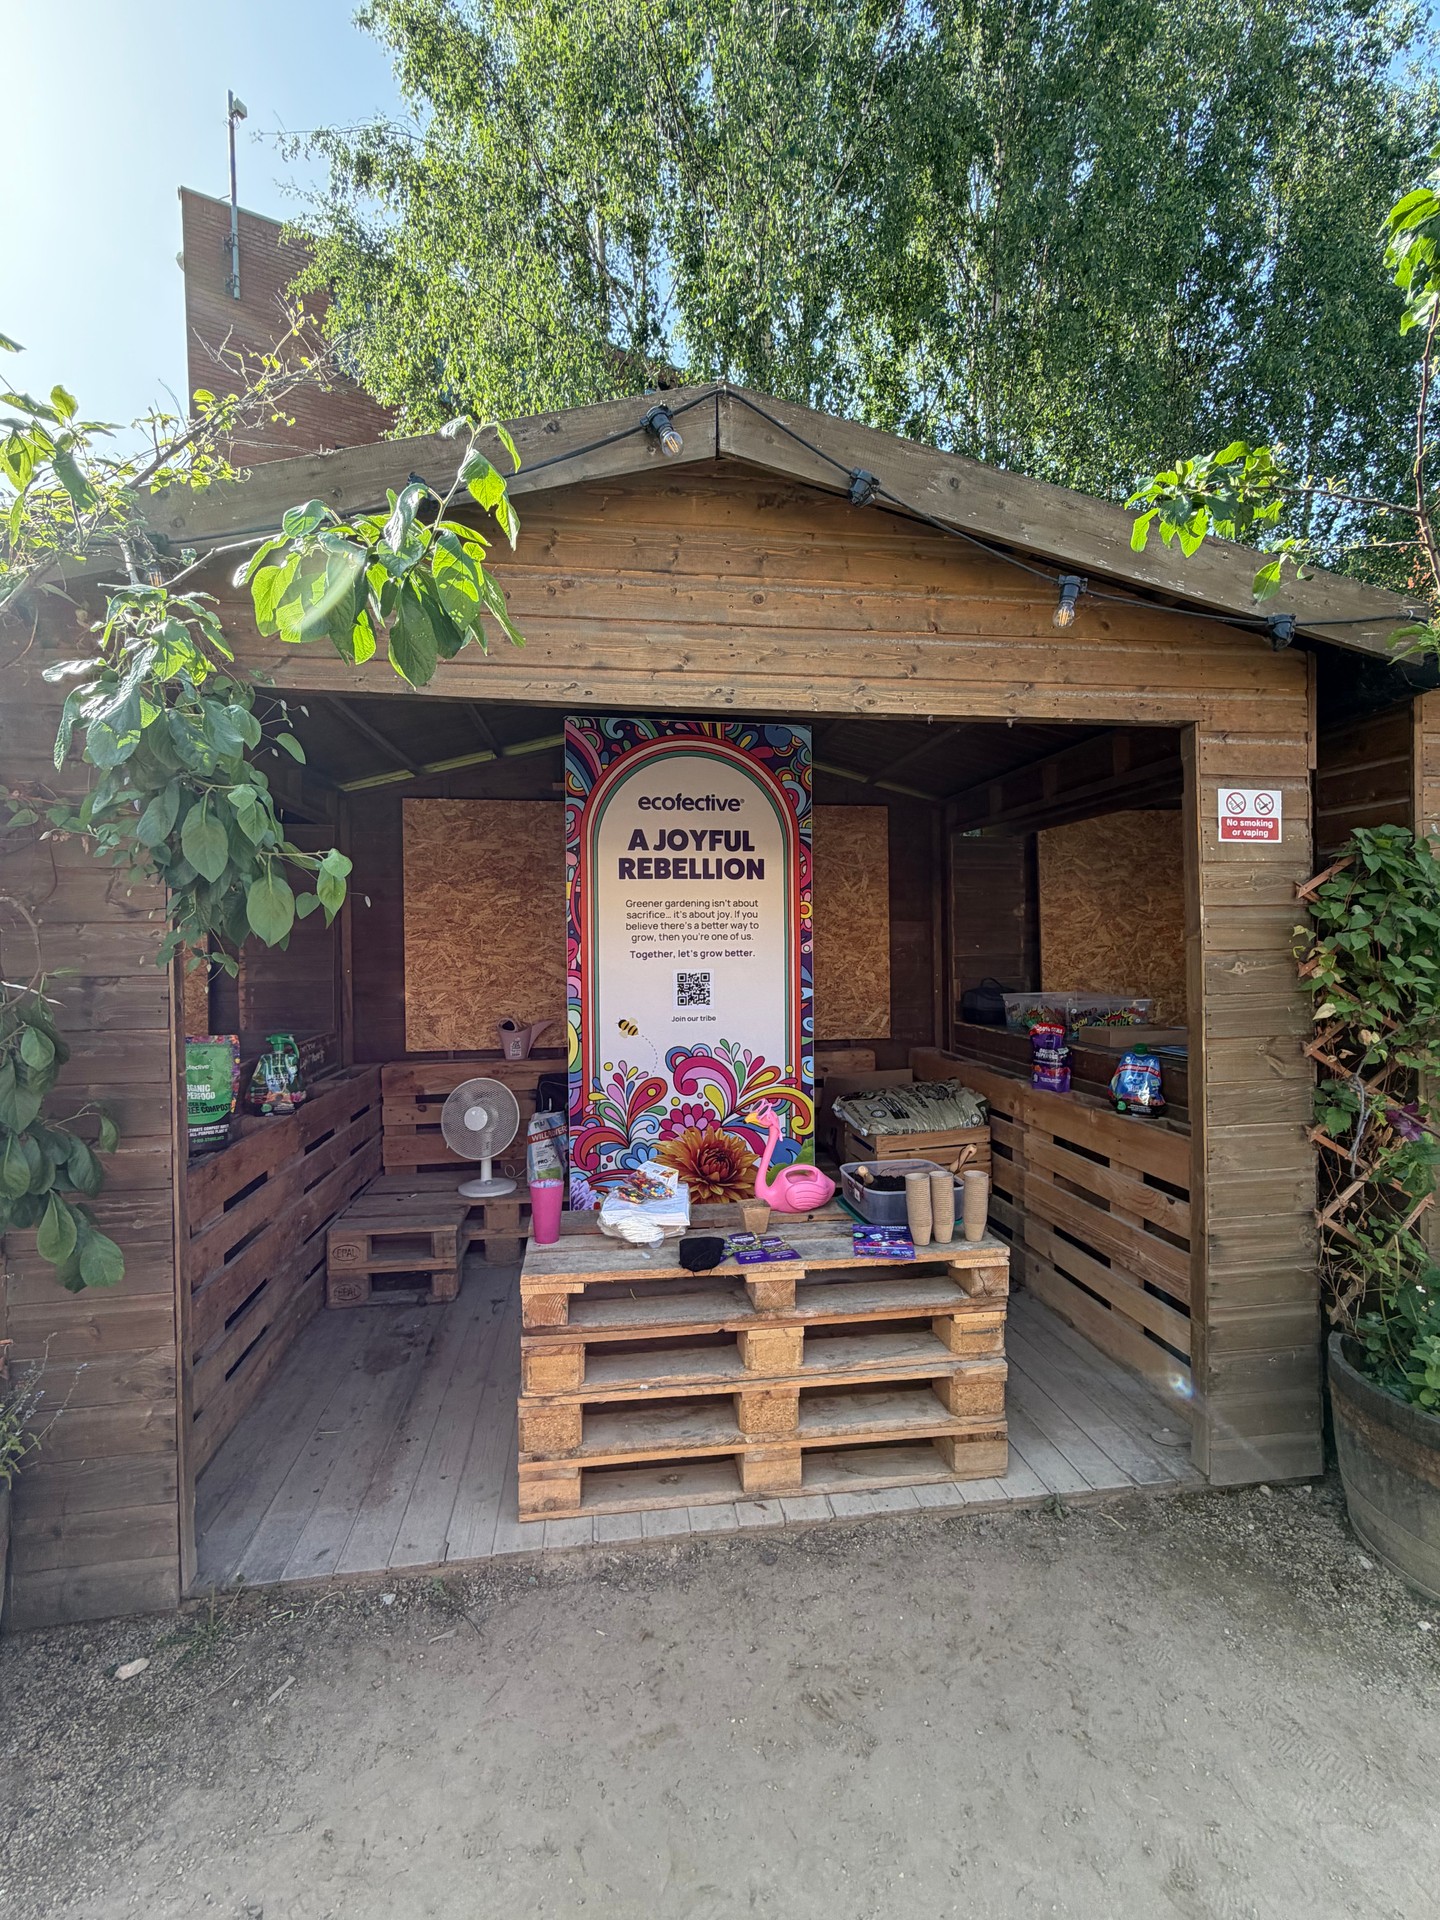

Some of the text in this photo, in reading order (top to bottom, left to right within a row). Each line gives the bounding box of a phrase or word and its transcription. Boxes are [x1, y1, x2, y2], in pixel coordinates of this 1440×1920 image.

[1240, 820, 1273, 829] smoking
[1243, 829, 1269, 838] vaping
[628, 829, 755, 851] A JOYFUL
[618, 858, 764, 880] REBELLION
[665, 899, 710, 909] gardening
[712, 899, 731, 907] isn't
[717, 911, 732, 920] joy.
[742, 912, 758, 920] you
[626, 922, 658, 930] believe
[660, 922, 692, 930] there's
[701, 922, 728, 930] better
[730, 923, 748, 931] way
[631, 935, 656, 944] grow,
[659, 933, 680, 941] then
[682, 933, 709, 942] you're
[630, 949, 755, 960] Together, let's grow better.
[1071, 1018, 1088, 1031] BOOM
[337, 1248, 356, 1258] EPAL
